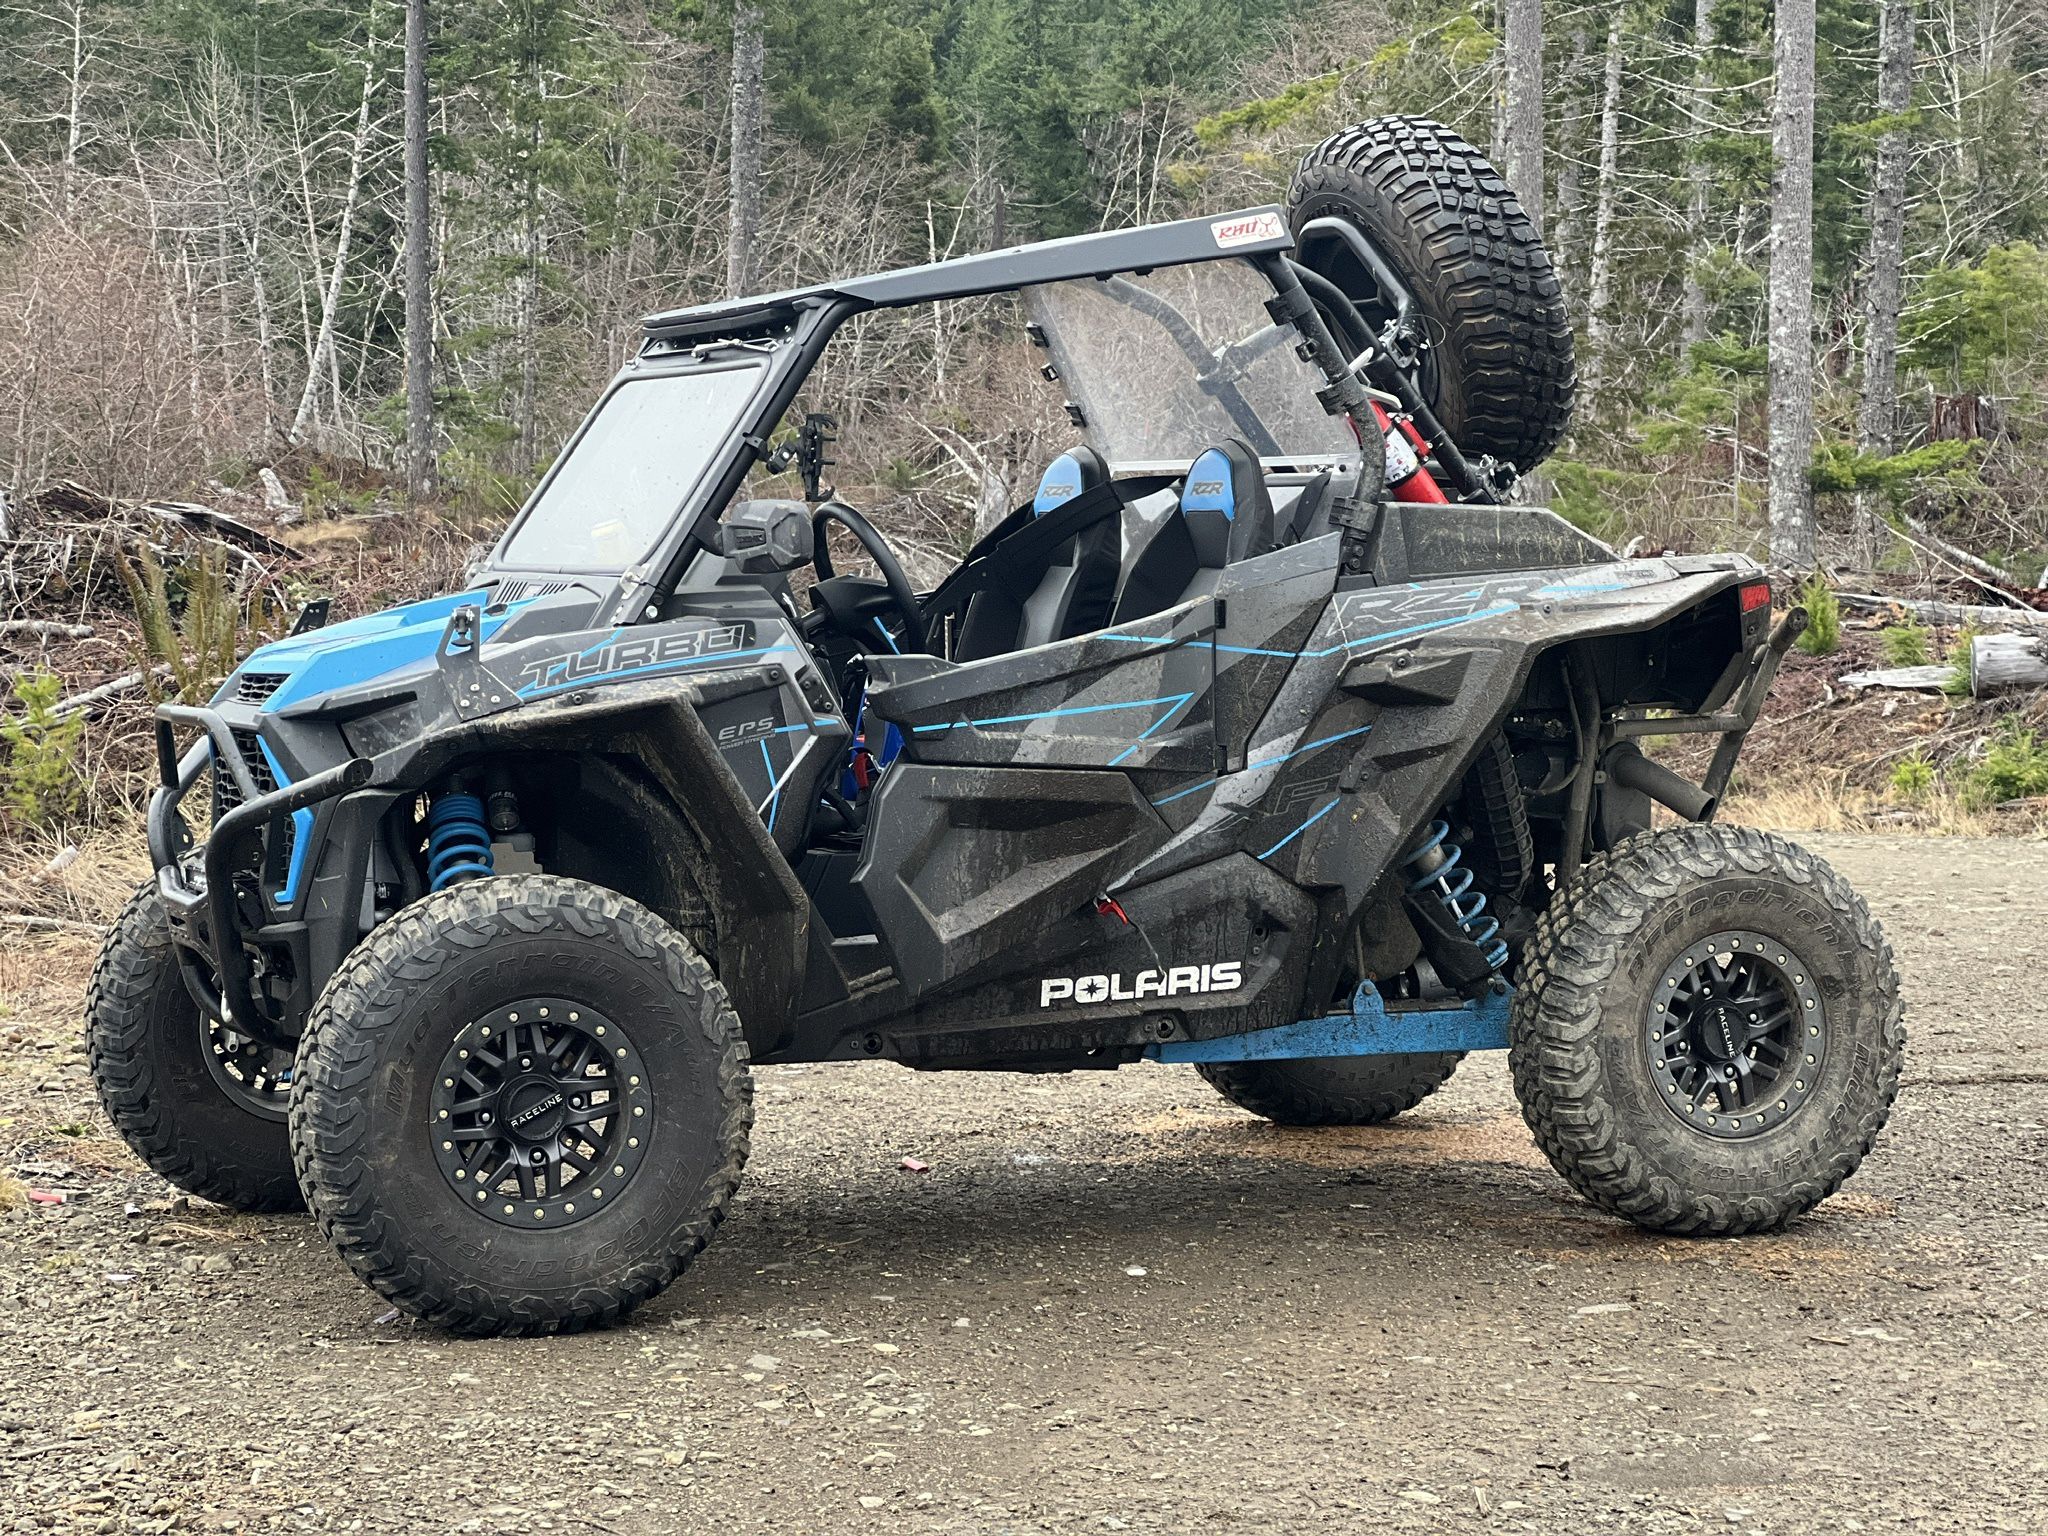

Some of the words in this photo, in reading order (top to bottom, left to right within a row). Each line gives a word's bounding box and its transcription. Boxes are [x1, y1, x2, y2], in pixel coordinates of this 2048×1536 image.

[1041, 485, 1074, 499] RZR
[1190, 480, 1225, 497] RZR
[1325, 577, 1550, 638] RZR
[520, 624, 745, 690] TURBO
[718, 716, 774, 740] EPS
[1040, 961, 1242, 1008] POLARIS
[1718, 1007, 1736, 1058] RACELINE
[510, 1093, 563, 1128] RACELINE
